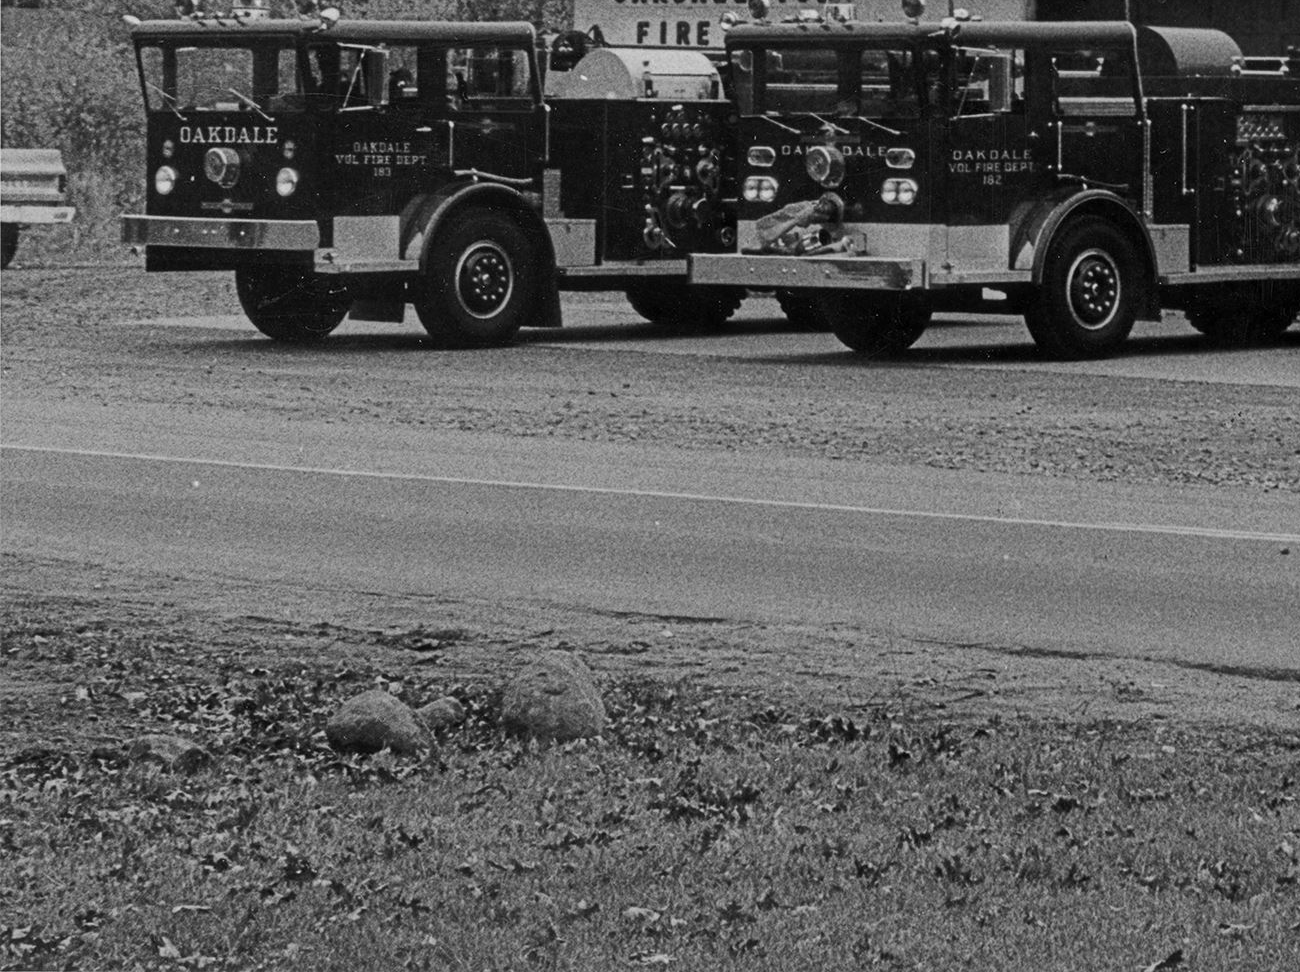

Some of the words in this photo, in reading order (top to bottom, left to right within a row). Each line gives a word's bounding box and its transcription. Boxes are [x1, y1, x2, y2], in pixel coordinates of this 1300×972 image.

[637, 21, 711, 45] FIRE
[180, 126, 278, 144] OAKDALE
[353, 141, 411, 153] OAKDALE
[335, 154, 359, 165] VOL
[364, 154, 392, 165] FIRE
[952, 149, 1032, 161] OAKDALE
[948, 162, 971, 173] VOL
[975, 162, 1001, 173] FIRE
[983, 174, 1002, 185] 182
